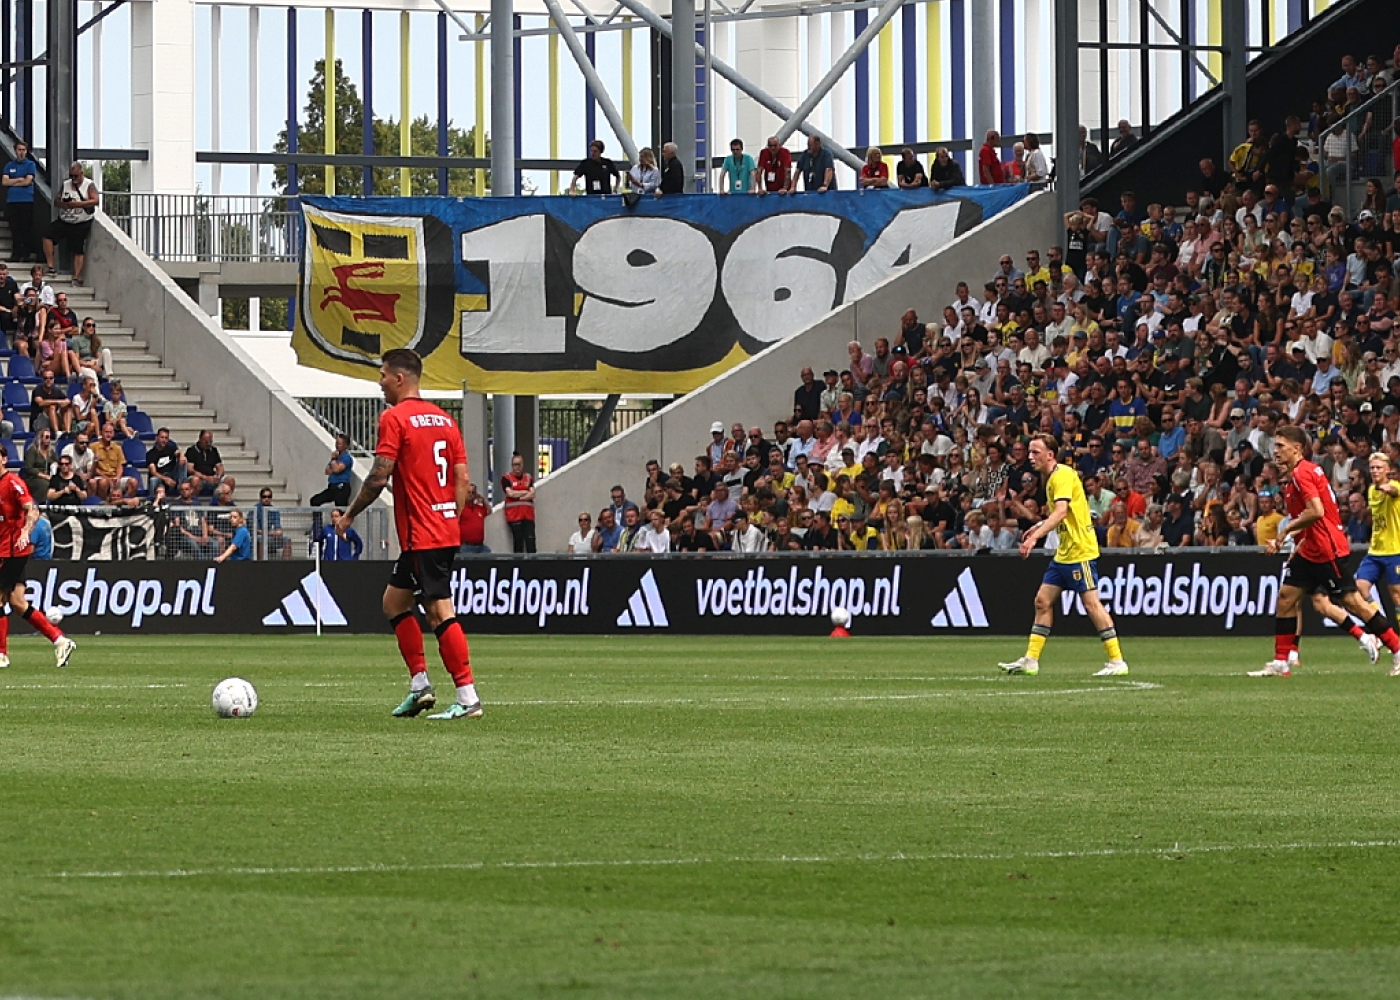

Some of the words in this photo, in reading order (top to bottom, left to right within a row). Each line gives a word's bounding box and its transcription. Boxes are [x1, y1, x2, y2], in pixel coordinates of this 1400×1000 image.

[461, 201, 964, 353] 1964
[433, 440, 449, 487] 5
[697, 565, 900, 629] voetbalshop.nl
